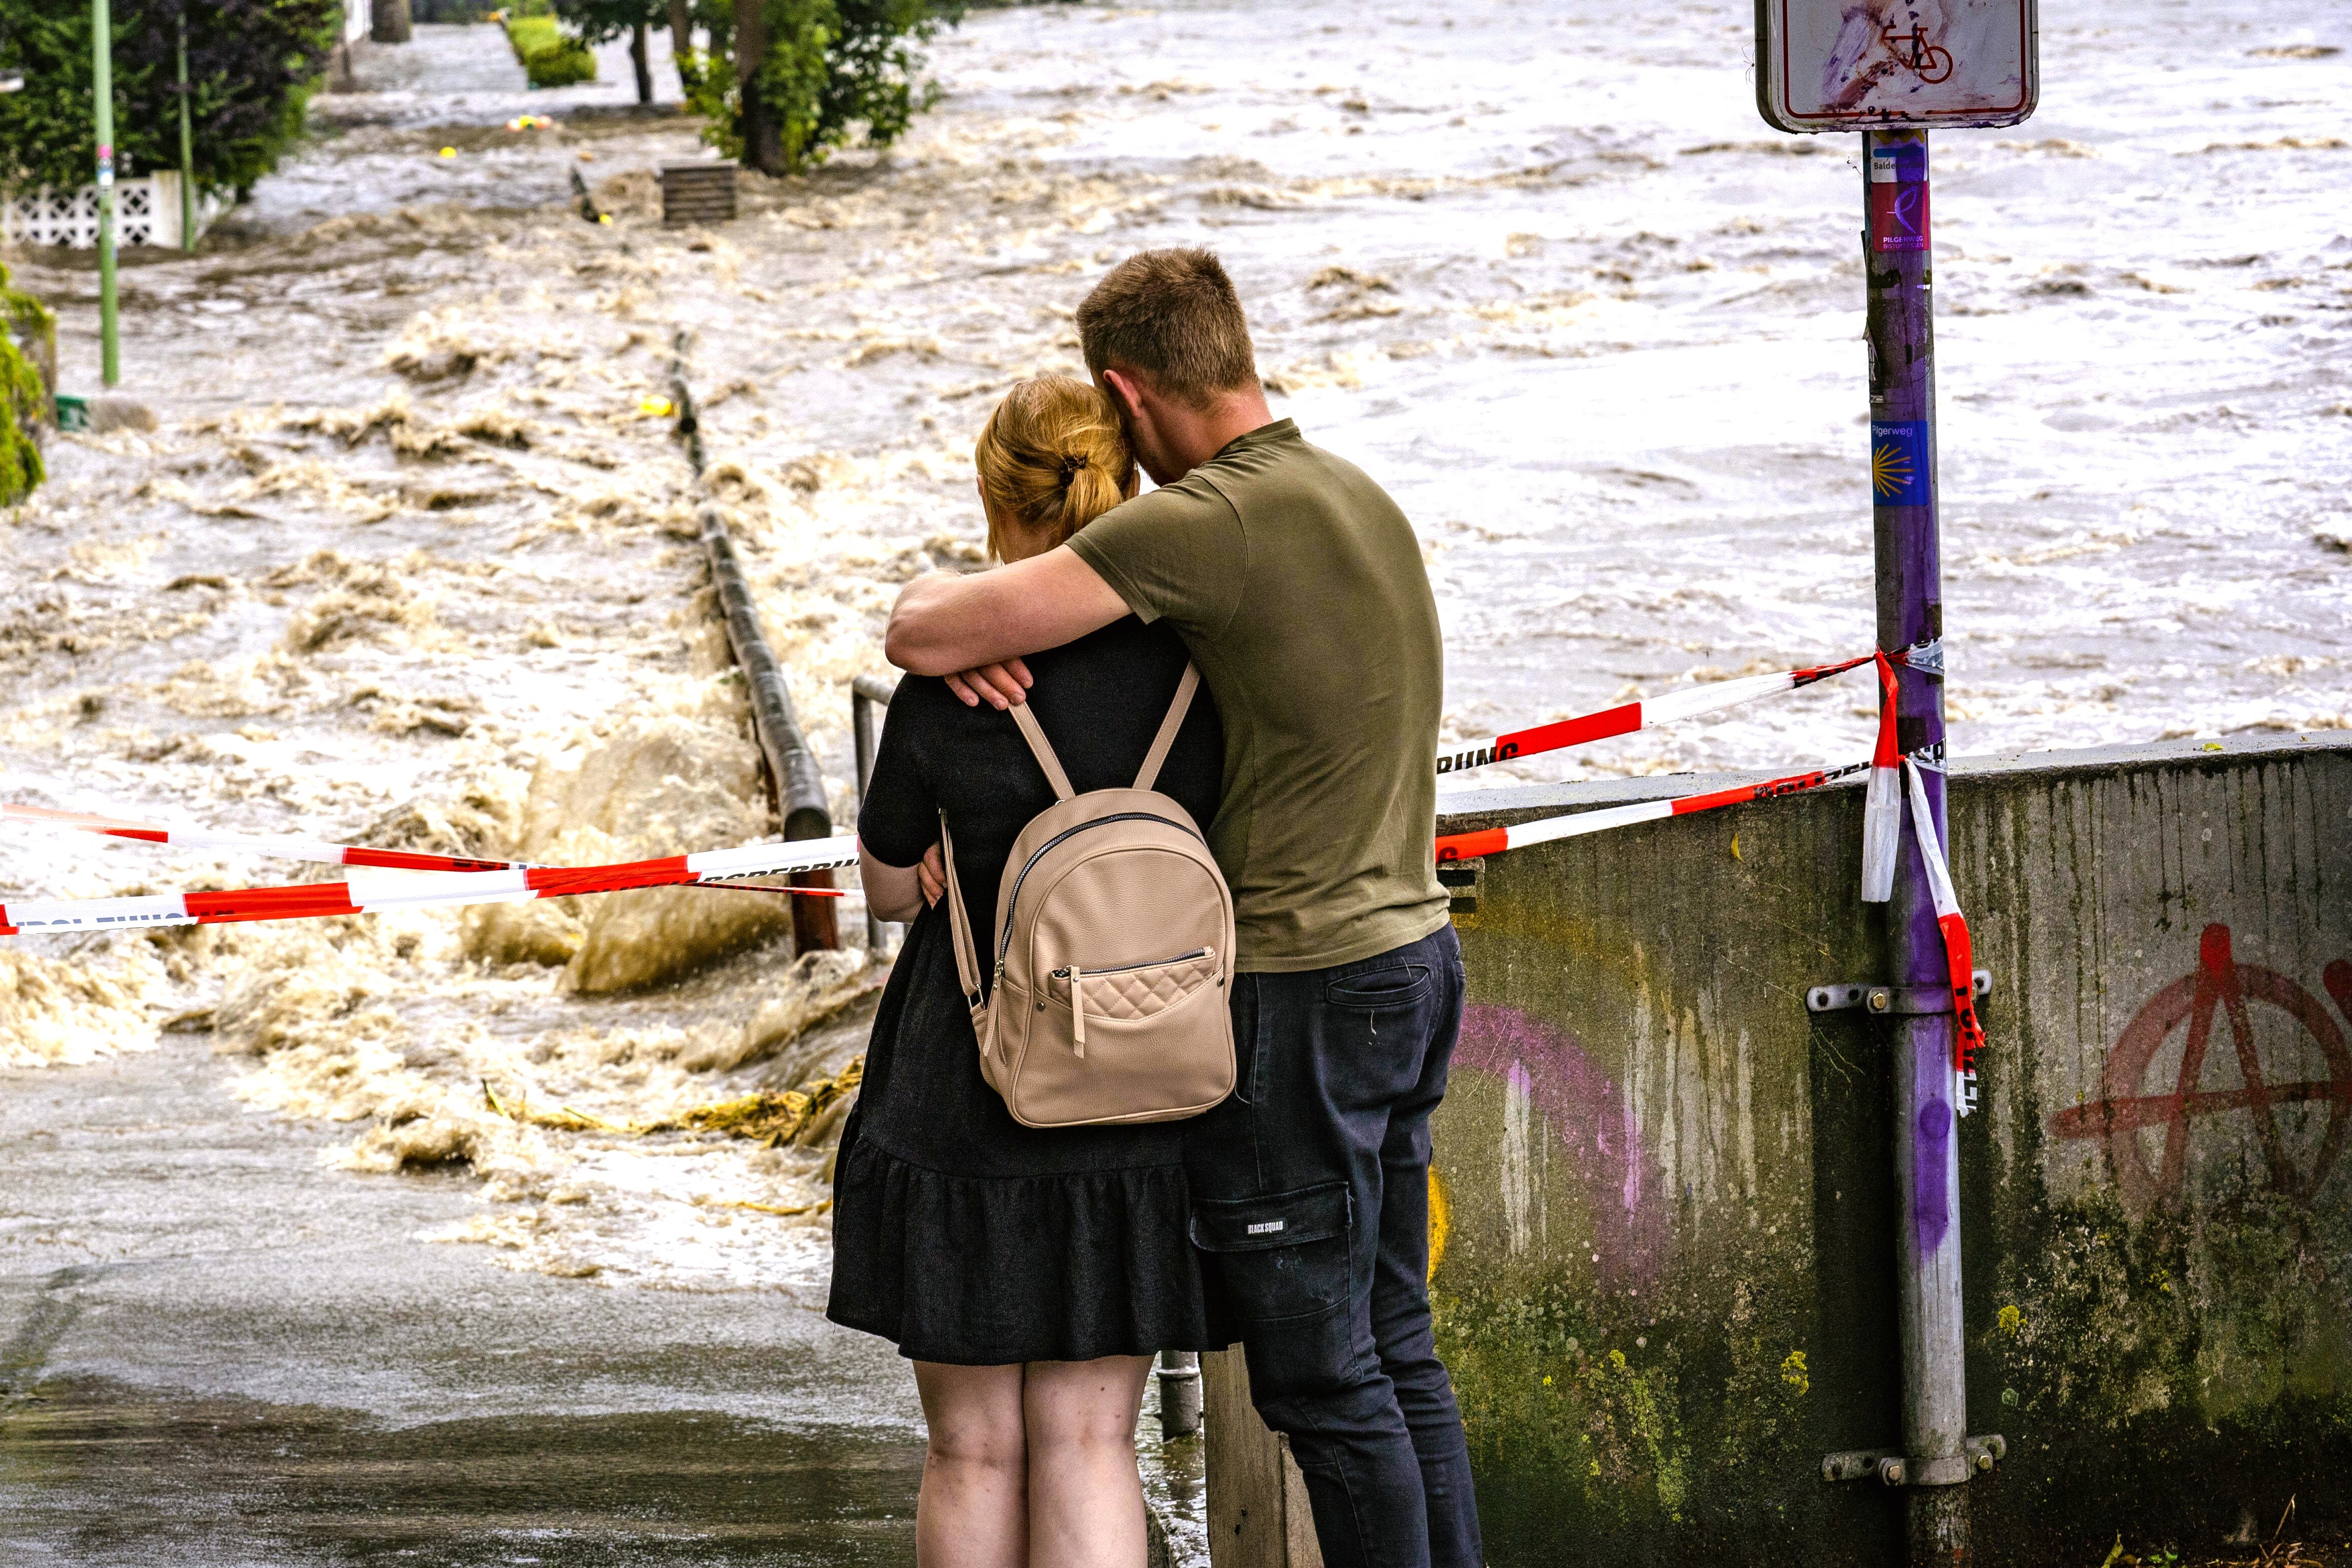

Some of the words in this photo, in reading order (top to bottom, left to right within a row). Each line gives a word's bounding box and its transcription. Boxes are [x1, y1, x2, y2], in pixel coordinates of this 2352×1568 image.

[1872, 425, 1913, 437] Pilgerweg
[1248, 1223, 1264, 1234] BLACK
[1265, 1220, 1283, 1233] SQUAD
